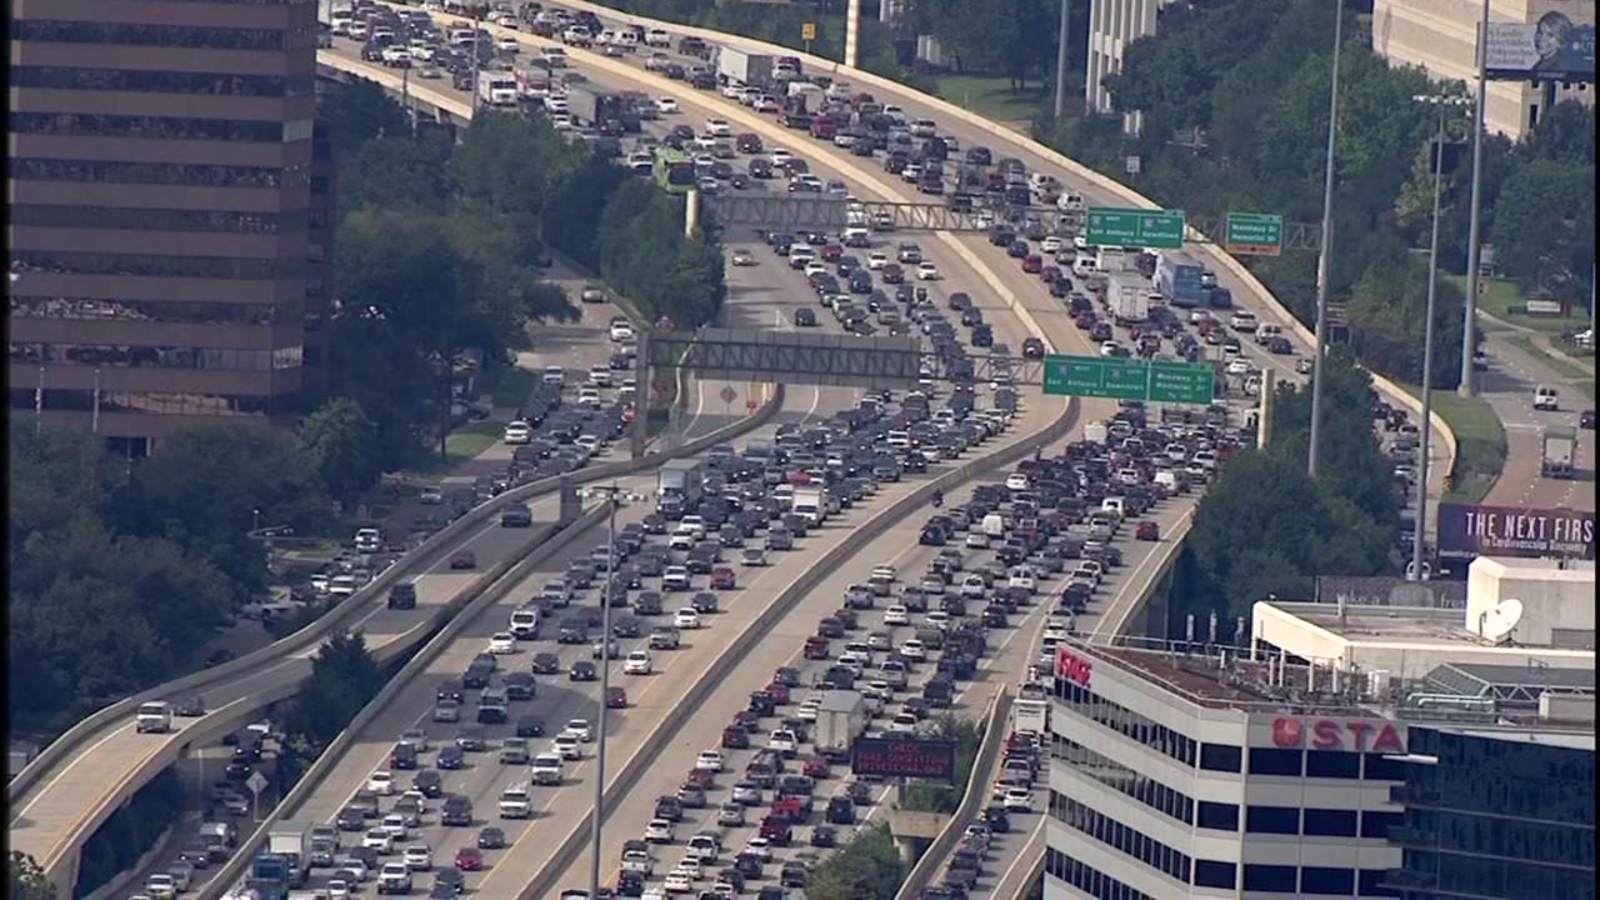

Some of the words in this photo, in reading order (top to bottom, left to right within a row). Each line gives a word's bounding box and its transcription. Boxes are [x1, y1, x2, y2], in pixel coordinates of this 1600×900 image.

[1466, 512, 1497, 537] THE
[1504, 515, 1548, 540] NEXT
[1554, 517, 1594, 543] FIRS
[1312, 719, 1405, 752] STA
